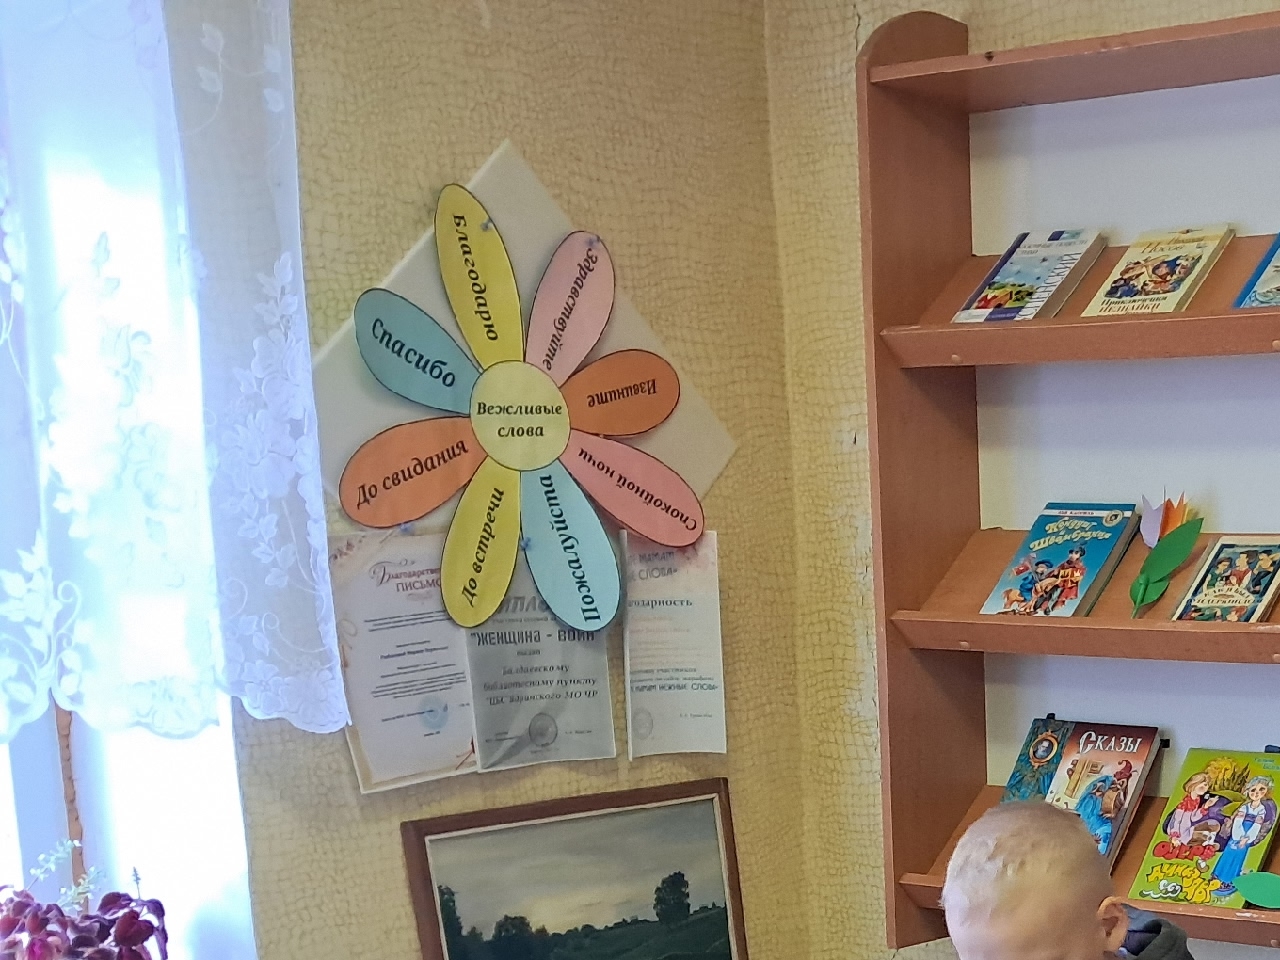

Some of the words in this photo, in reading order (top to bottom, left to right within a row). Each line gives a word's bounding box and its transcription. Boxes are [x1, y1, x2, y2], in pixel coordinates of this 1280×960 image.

[453, 214, 499, 342] Благодарю
[544, 247, 598, 371] Здравствуйте
[1017, 253, 1081, 317] СПЕНСКИЙ
[371, 318, 456, 389] Спасибо
[476, 402, 563, 417] Вежливые
[587, 379, 657, 408] Извините
[497, 424, 545, 437] слова
[578, 447, 614, 475] ночи
[356, 485, 379, 510] До
[382, 439, 470, 489] свидания
[617, 472, 698, 532] Спокойной
[460, 578, 479, 608] До
[474, 486, 505, 574] встречи
[539, 474, 601, 624] Пожалуйста
[1079, 731, 1142, 754] СКАЗЫ
